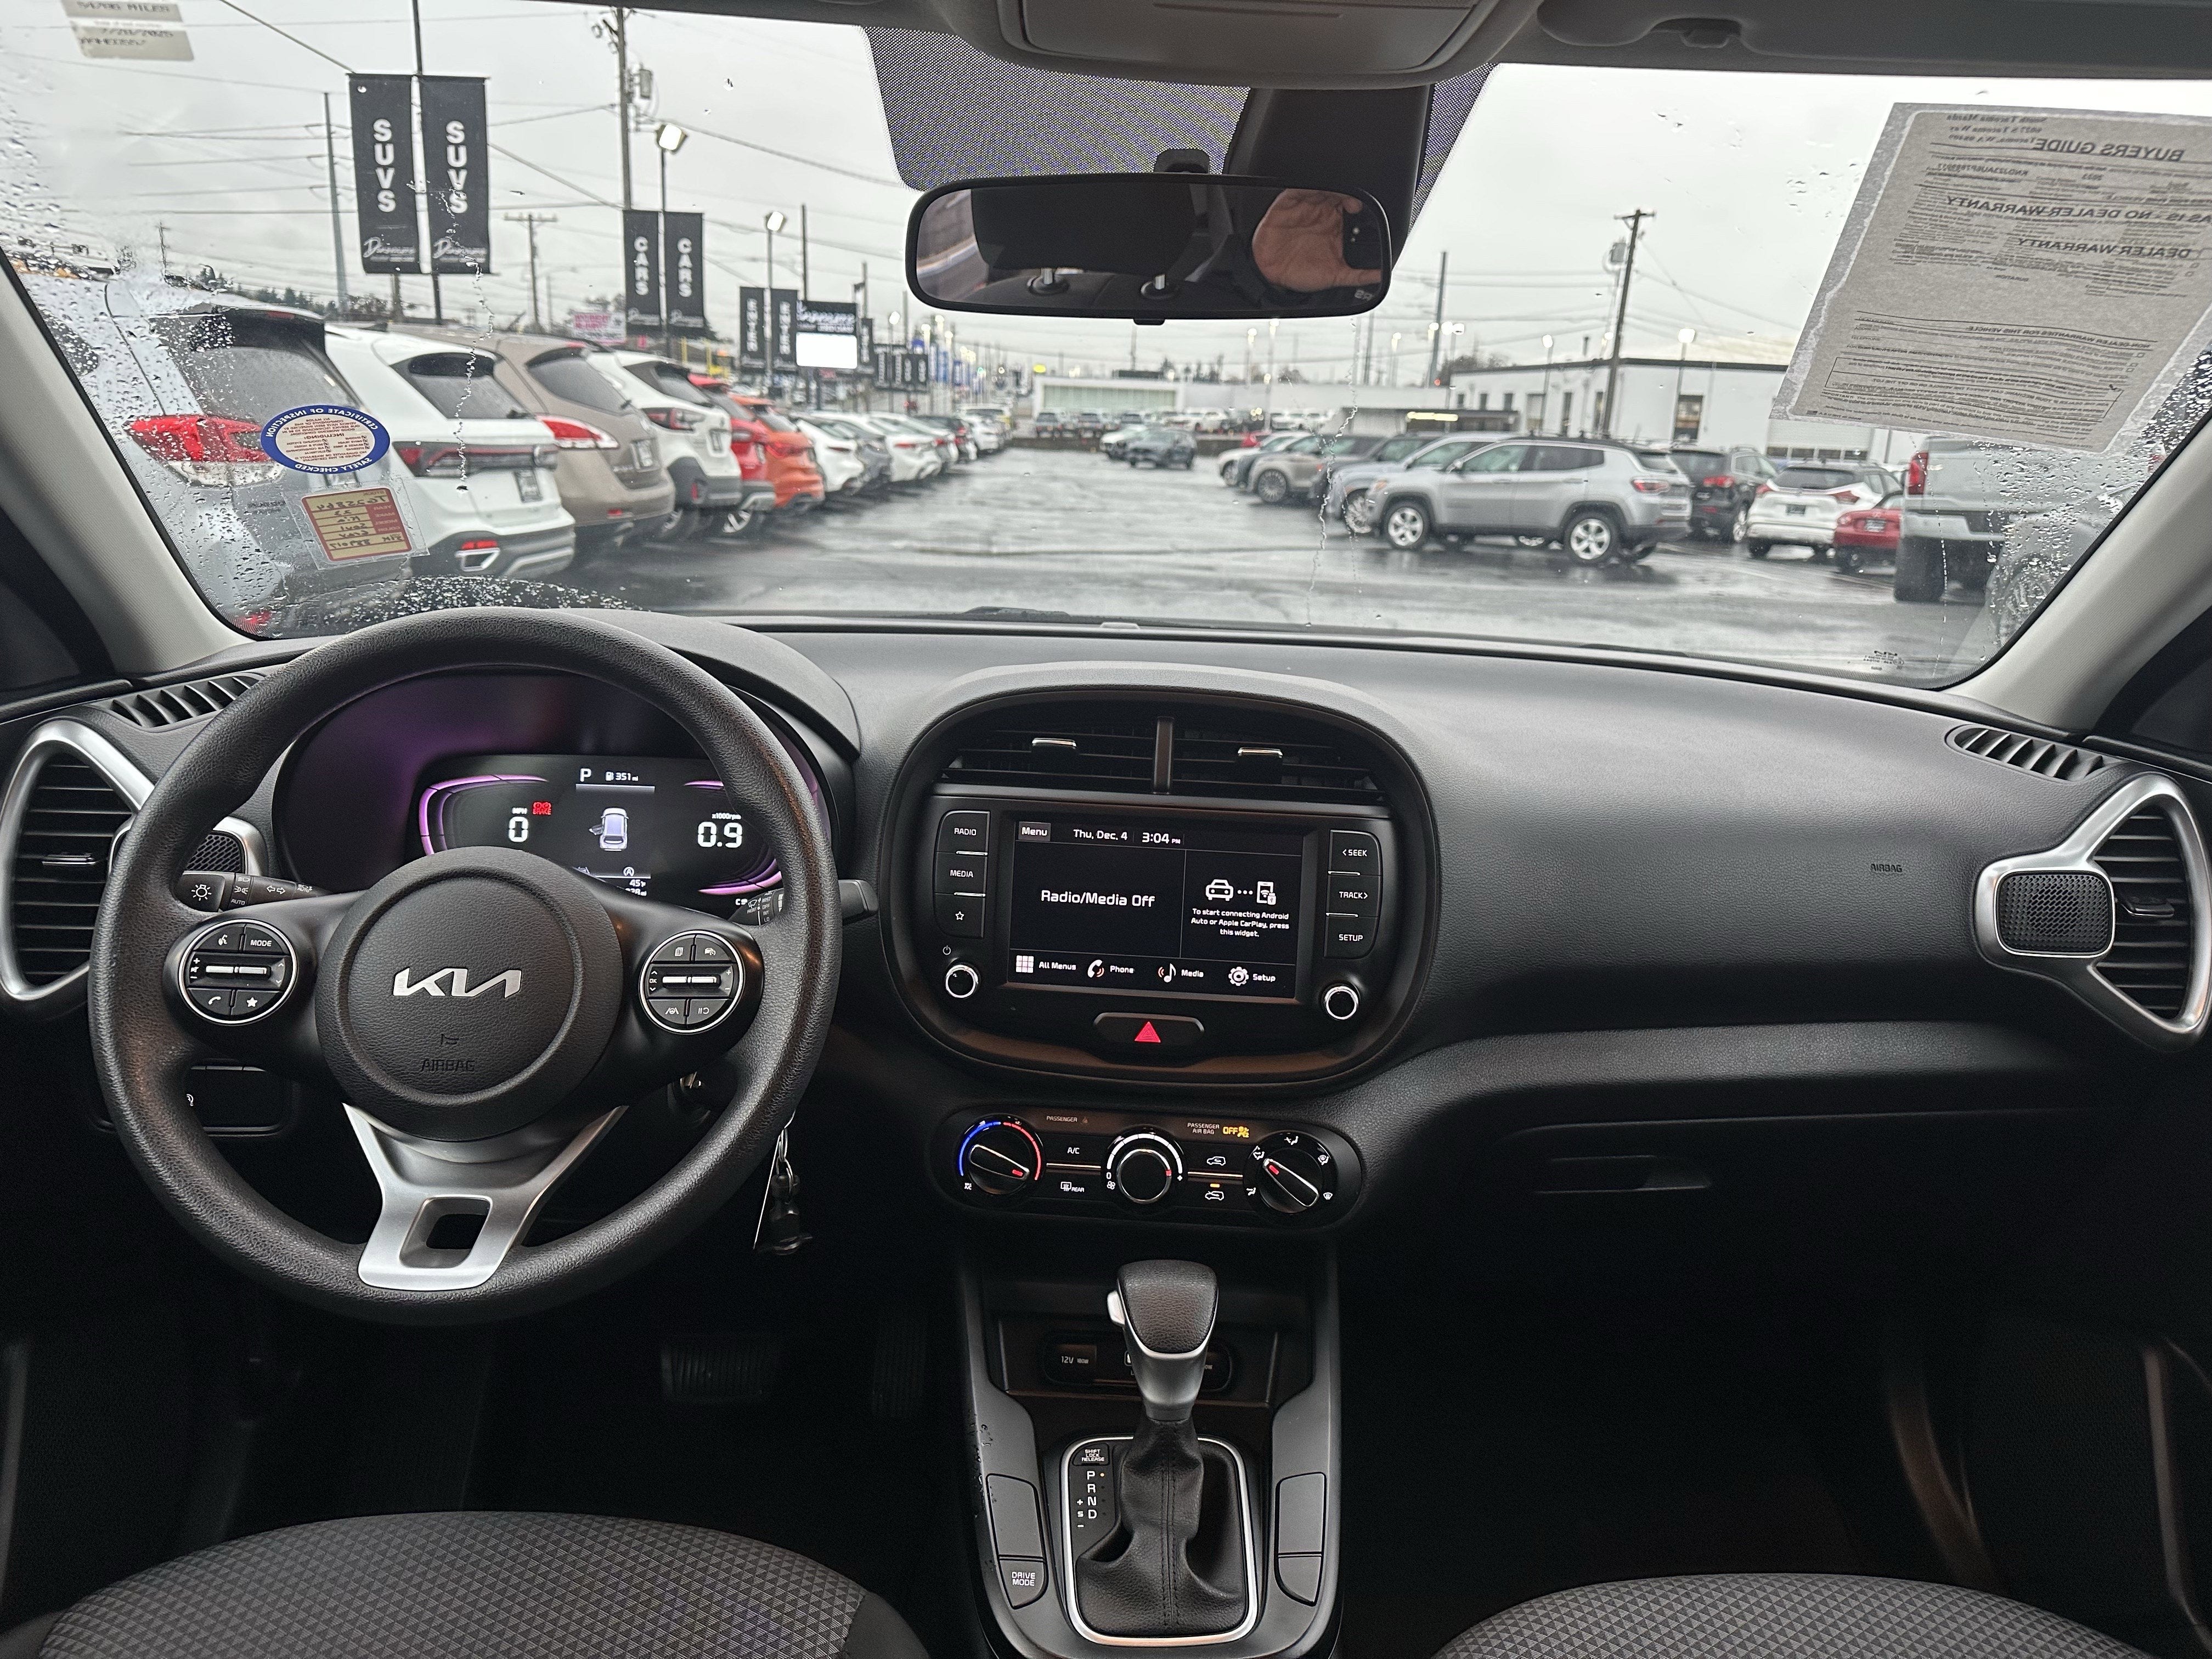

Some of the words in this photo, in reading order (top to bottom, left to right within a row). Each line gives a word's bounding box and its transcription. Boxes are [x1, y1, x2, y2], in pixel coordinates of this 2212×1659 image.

[373, 119, 396, 212] SUVS
[446, 121, 467, 213] SUVS
[634, 236, 649, 295] CARS
[677, 238, 692, 297] CARS
[579, 768, 592, 782] P
[615, 772, 631, 781] 351
[508, 816, 529, 843] 0
[697, 821, 743, 848] 0.9
[954, 827, 977, 836] RADIO
[1022, 826, 1048, 836] Menu
[1073, 829, 1094, 839] Thu,
[1097, 830, 1118, 840] Dec.
[1120, 832, 1128, 840] 4
[1142, 832, 1170, 844] 3:04
[1870, 863, 1903, 873] AIRBAG
[950, 870, 974, 878] MEDIA
[1041, 890, 1127, 906] Radio/Media
[1132, 895, 1155, 907] Off
[1221, 911, 1260, 919] connecting
[250, 939, 272, 947] MODE
[1051, 962, 1076, 970] Menus
[1110, 965, 1134, 974] Phone
[1181, 969, 1204, 978] Media
[1252, 973, 1276, 982] Setup
[393, 967, 522, 999] KIA
[421, 1059, 476, 1071] AIRBAG
[1223, 1126, 1238, 1135] OFF
[1062, 1356, 1074, 1364] 12V
[1087, 1470, 1095, 1480] P
[1087, 1483, 1096, 1493] R
[1087, 1496, 1097, 1506] N
[1088, 1509, 1097, 1519] D
